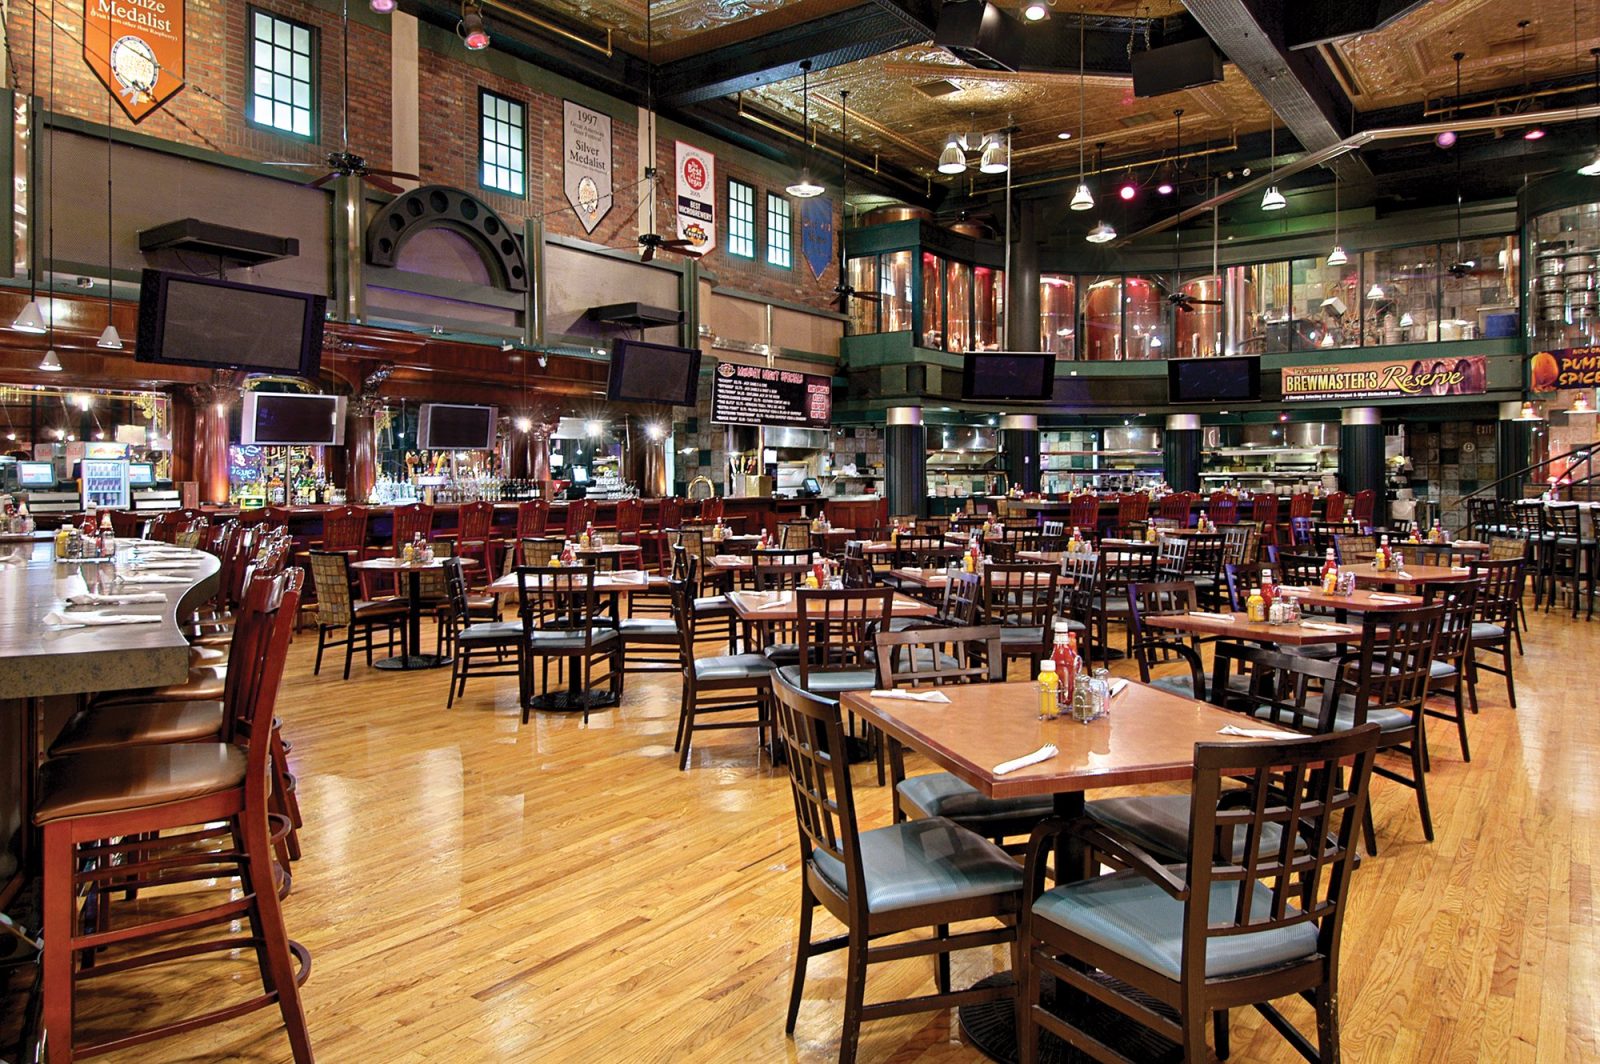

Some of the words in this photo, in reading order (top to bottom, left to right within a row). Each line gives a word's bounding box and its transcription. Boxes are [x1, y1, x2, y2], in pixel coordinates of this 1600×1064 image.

[98, 0, 172, 32] Medalist
[577, 110, 598, 126] 1997
[575, 139, 599, 156] Silver
[570, 149, 606, 170] Medalist
[1286, 372, 1378, 391] BREWMASTER'S
[1379, 365, 1465, 393] Reserve
